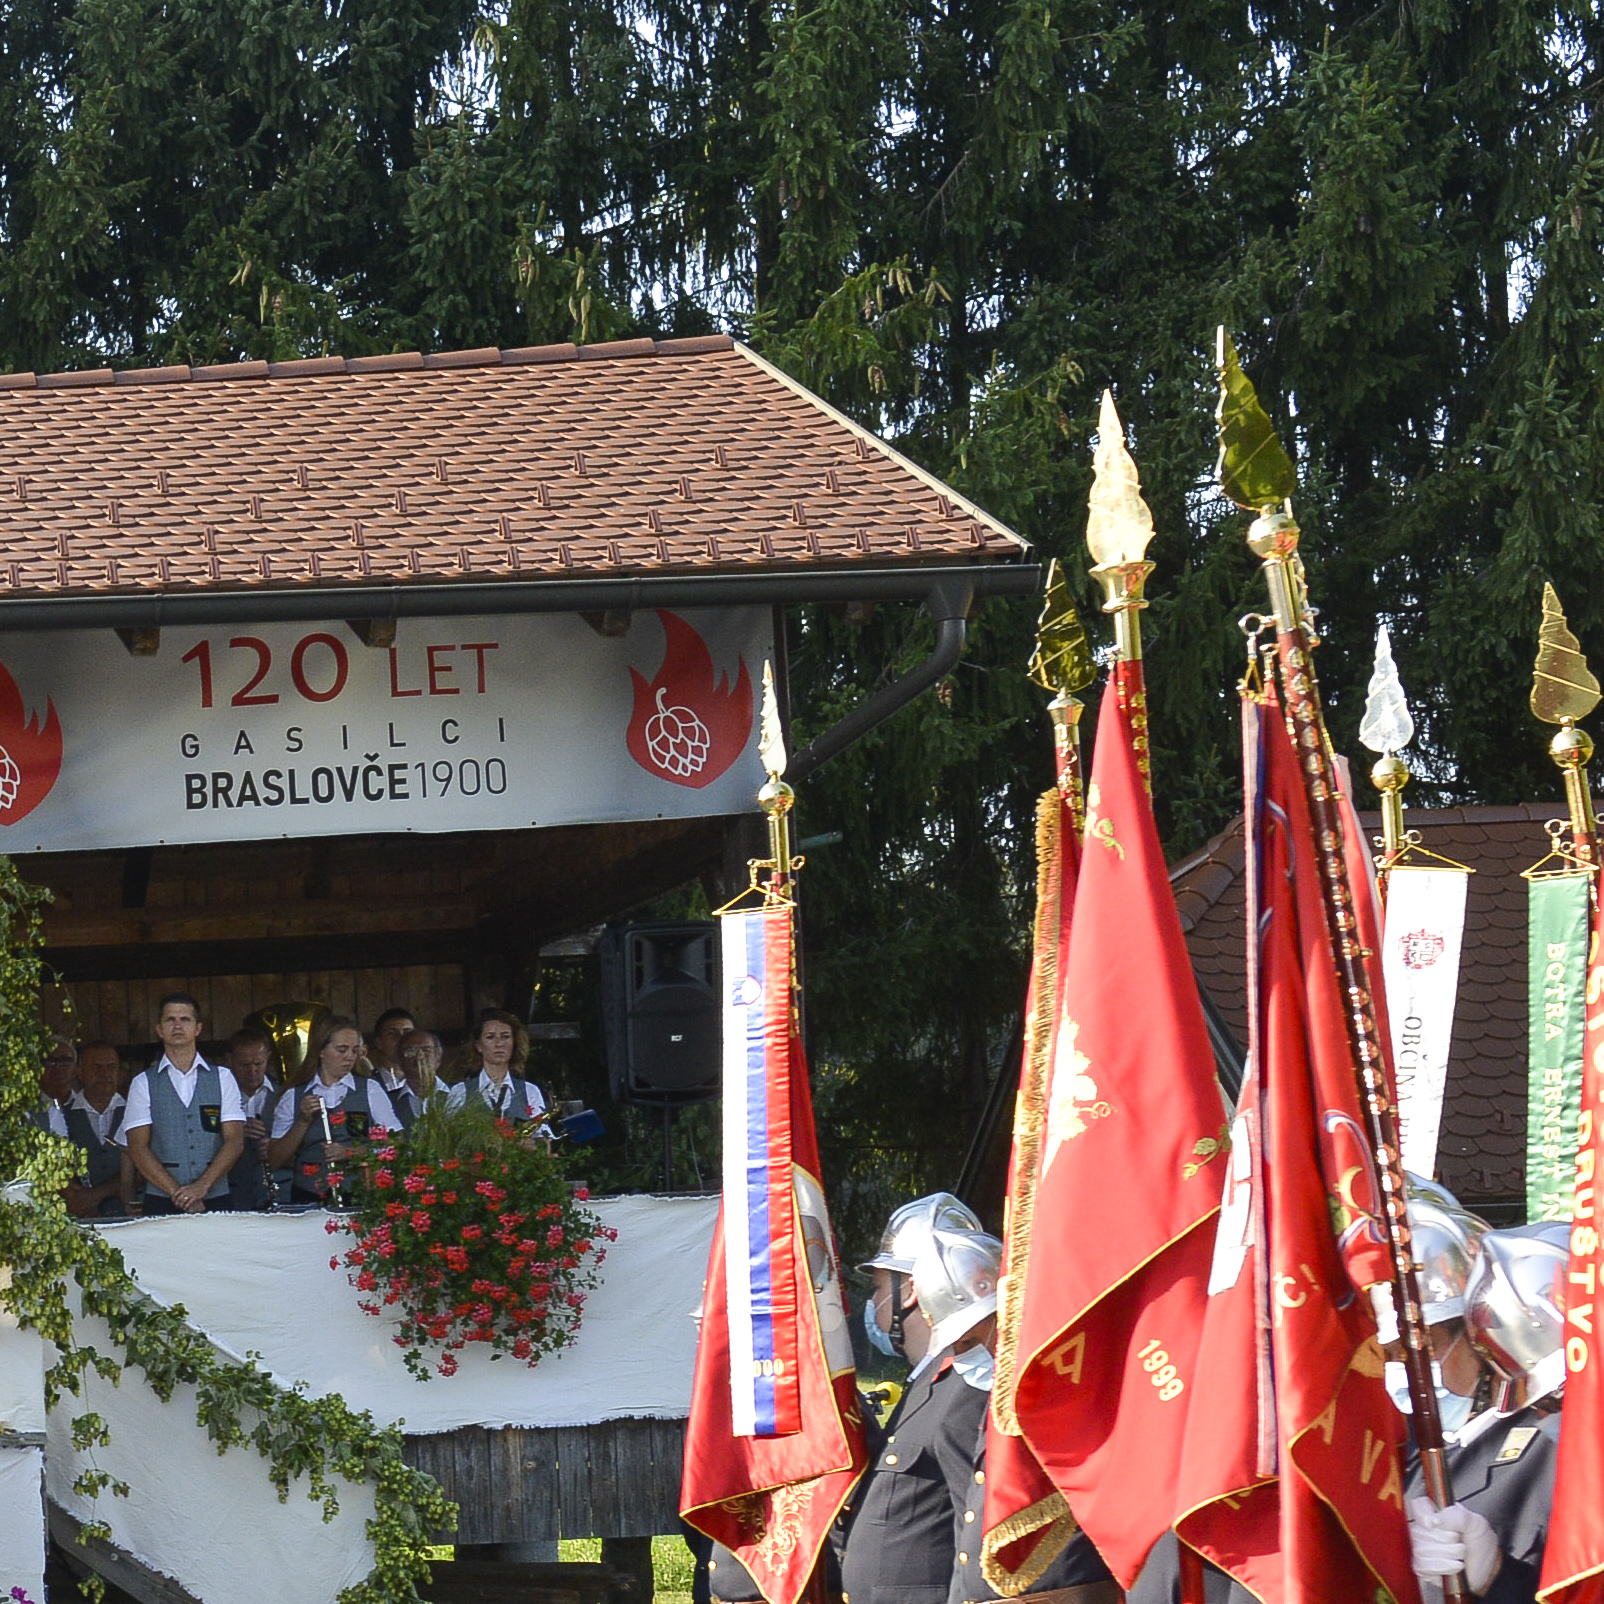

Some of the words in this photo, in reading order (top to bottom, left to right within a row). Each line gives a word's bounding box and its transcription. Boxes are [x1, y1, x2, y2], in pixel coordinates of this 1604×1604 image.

[181, 632, 349, 708] 120
[389, 641, 500, 698] LET
[180, 717, 506, 758] GASILCI
[1544, 941, 1568, 1042] BOTRA
[1396, 1015, 1428, 1103] OBČINA
[1542, 1067, 1564, 1177] ERNEST
[1565, 1107, 1600, 1374] DRUŠTVO
[753, 1358, 784, 1378] 000
[1137, 1339, 1185, 1402] 1999
